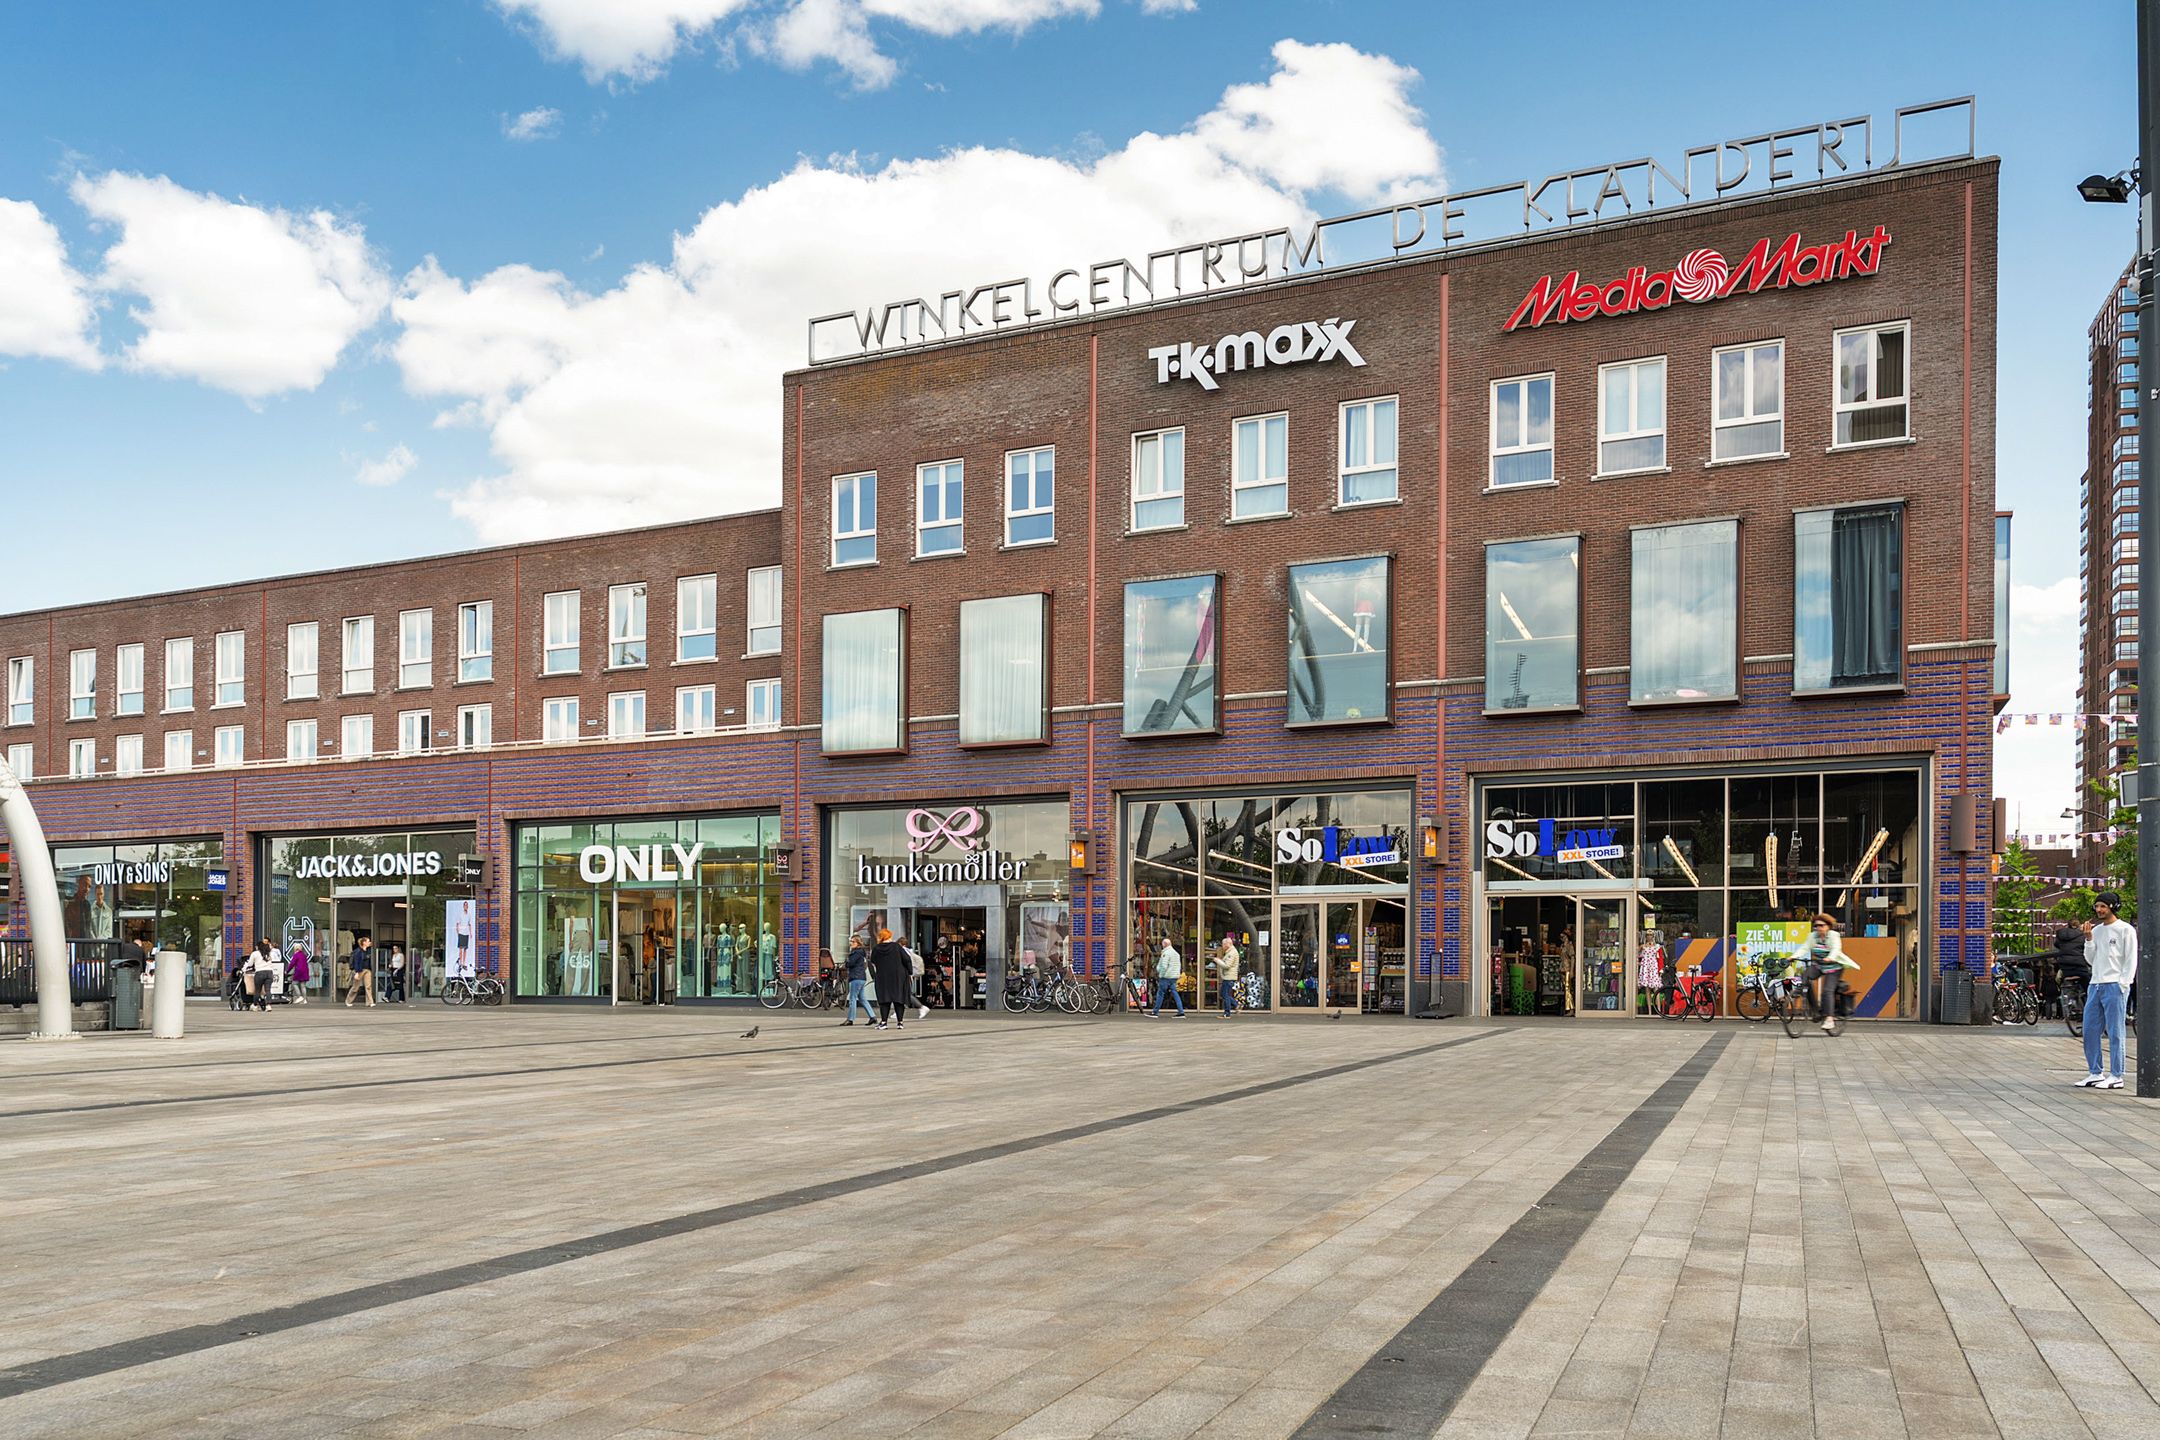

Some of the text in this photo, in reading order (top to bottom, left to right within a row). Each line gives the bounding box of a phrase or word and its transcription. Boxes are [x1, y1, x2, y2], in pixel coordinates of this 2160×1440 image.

[852, 220, 1324, 348] WINKELCENTRUM
[1392, 194, 1465, 249] DE
[1502, 225, 1892, 333] Media Markt
[295, 850, 442, 879] JACK&JONES
[579, 842, 705, 884] ONLY
[857, 849, 1028, 884] hunkemöller
[1344, 853, 1396, 867] XXL STORE!
[1563, 848, 1620, 861] XXL STORE!
[95, 863, 124, 885] ONLY
[135, 861, 168, 884] SONS
[464, 867, 481, 875] ONLY
[1746, 930, 1764, 941] ZIE
